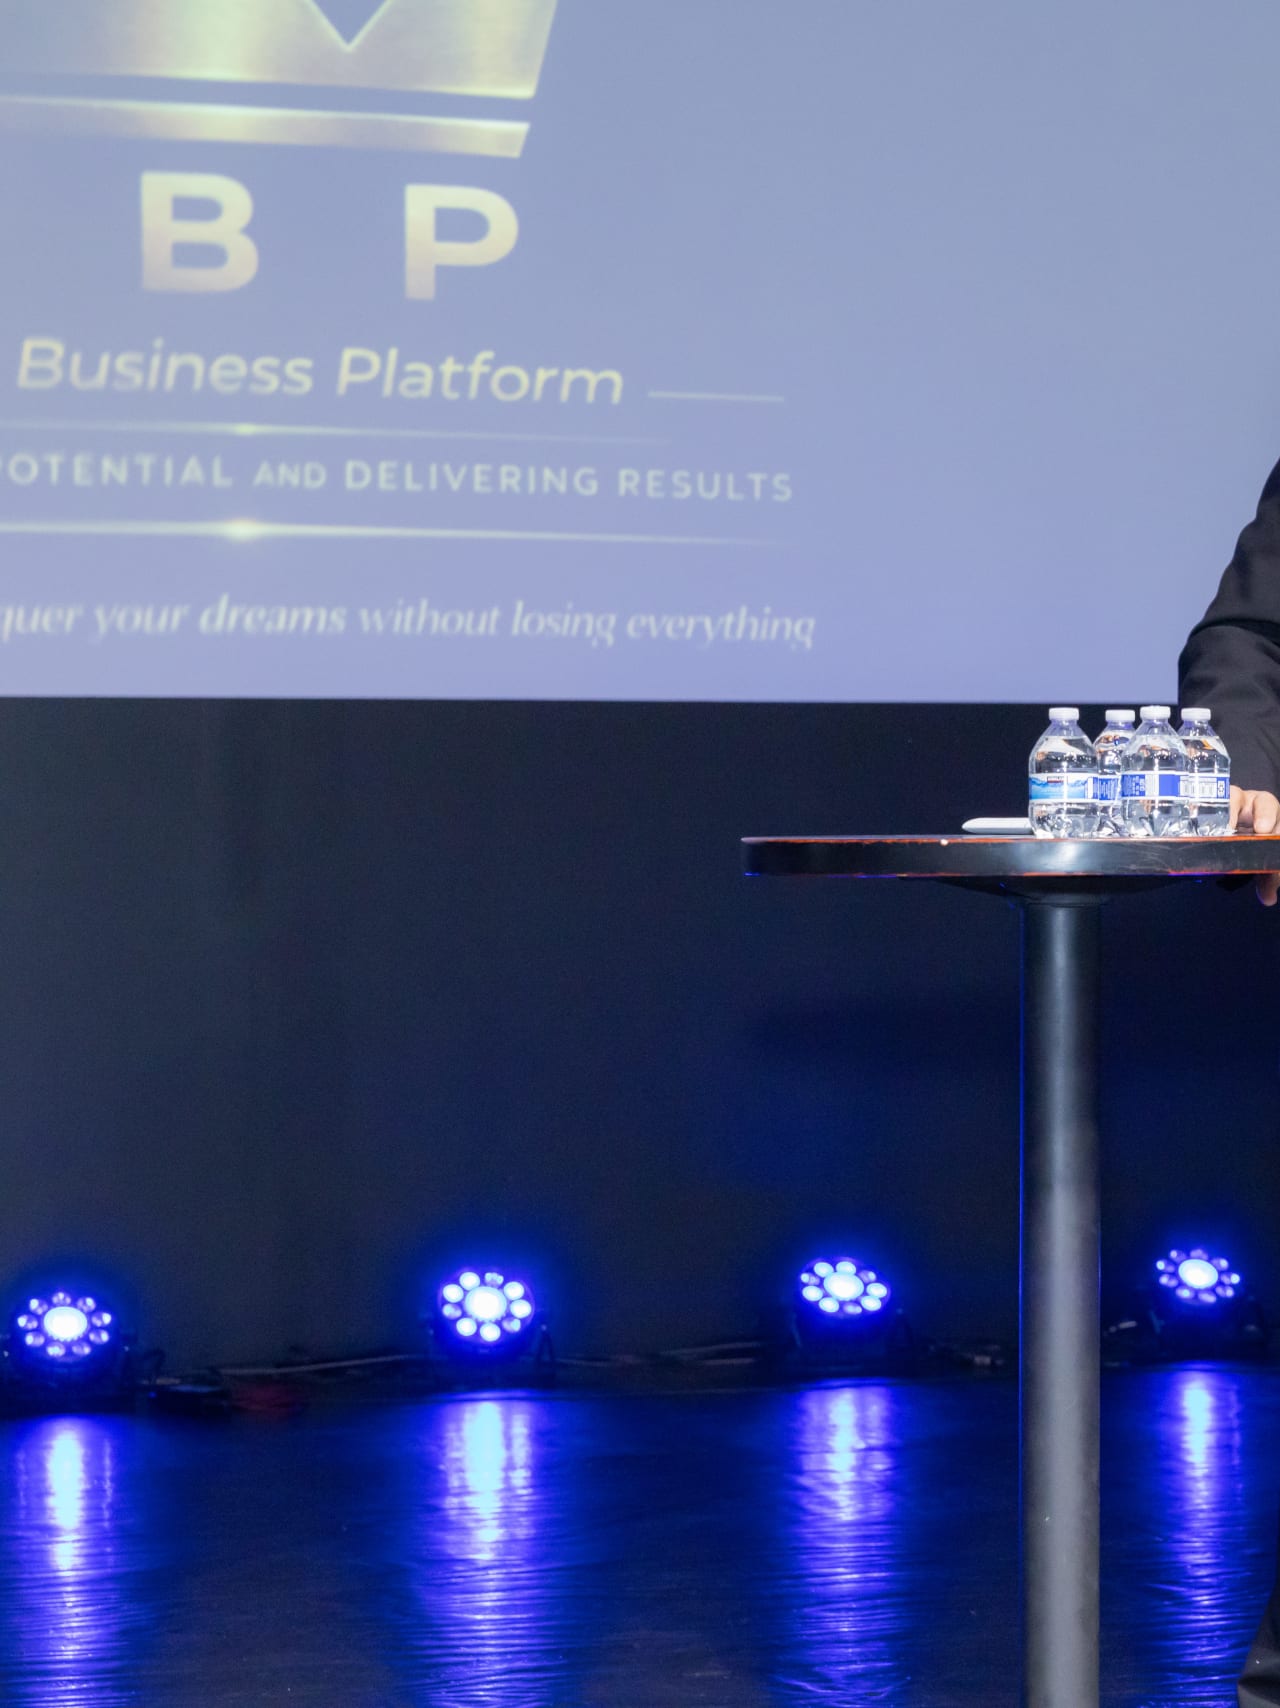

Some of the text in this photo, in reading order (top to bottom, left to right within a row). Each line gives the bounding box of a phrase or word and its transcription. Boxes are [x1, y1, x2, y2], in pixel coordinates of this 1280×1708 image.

[139, 171, 519, 301] B P
[16, 336, 624, 405] Business Platform
[0, 452, 793, 503] OTENTIAL AND DELIVERING RESULTS
[90, 602, 190, 643] your
[199, 592, 347, 637] dreams
[359, 597, 501, 637] without
[511, 599, 617, 648] losing
[626, 604, 816, 651] everything
